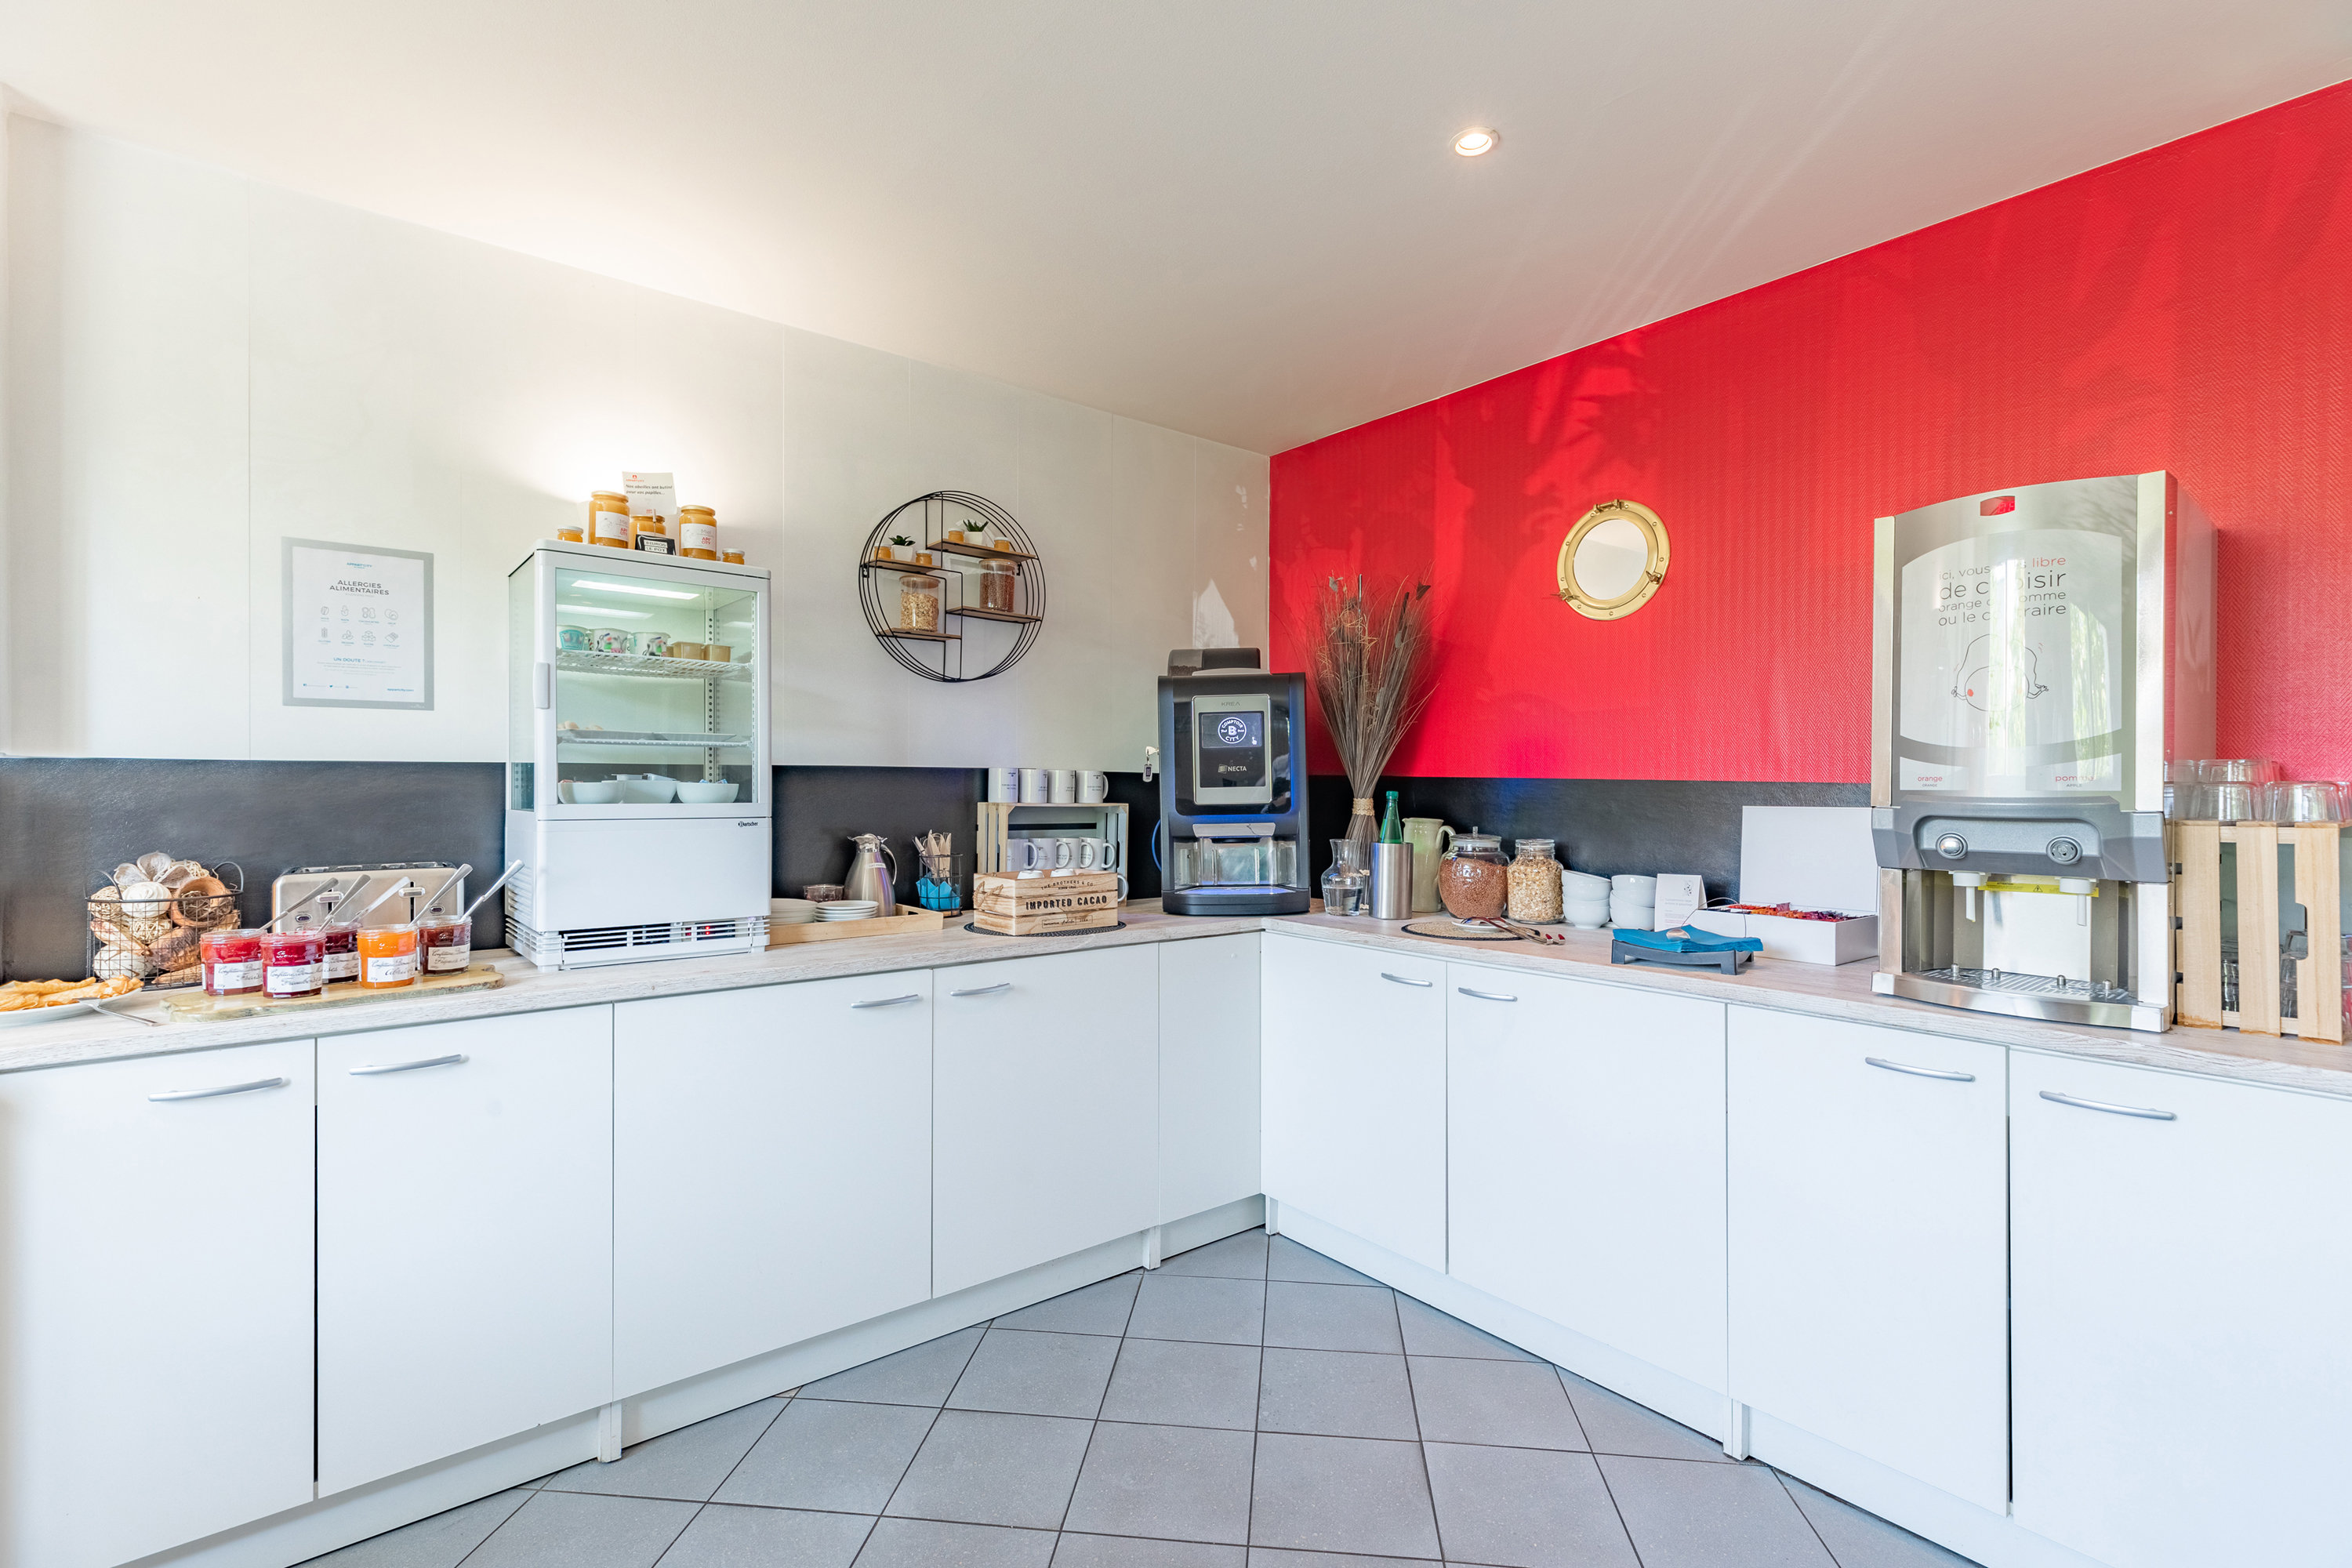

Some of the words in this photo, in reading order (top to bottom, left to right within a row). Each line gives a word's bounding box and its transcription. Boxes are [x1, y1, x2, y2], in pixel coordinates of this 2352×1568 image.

[1940, 569, 1955, 580] ici,
[1958, 565, 1991, 577] vous
[2032, 557, 2067, 568] libre
[329, 585, 390, 596] ALIMENTAIRES
[337, 579, 382, 589] ALLERGIES
[1940, 582, 1967, 601] de
[1976, 569, 2067, 595] coisir
[1938, 600, 1982, 612] orange
[2018, 591, 2067, 603] omme
[1938, 615, 1957, 626] ou
[1963, 612, 1976, 623] le
[1982, 603, 2067, 622] craire
[1221, 720, 1243, 728] COMPTOIR
[1228, 725, 1237, 735] B
[1025, 898, 1072, 910] IMPORTED
[1077, 895, 1107, 906] CACAO
